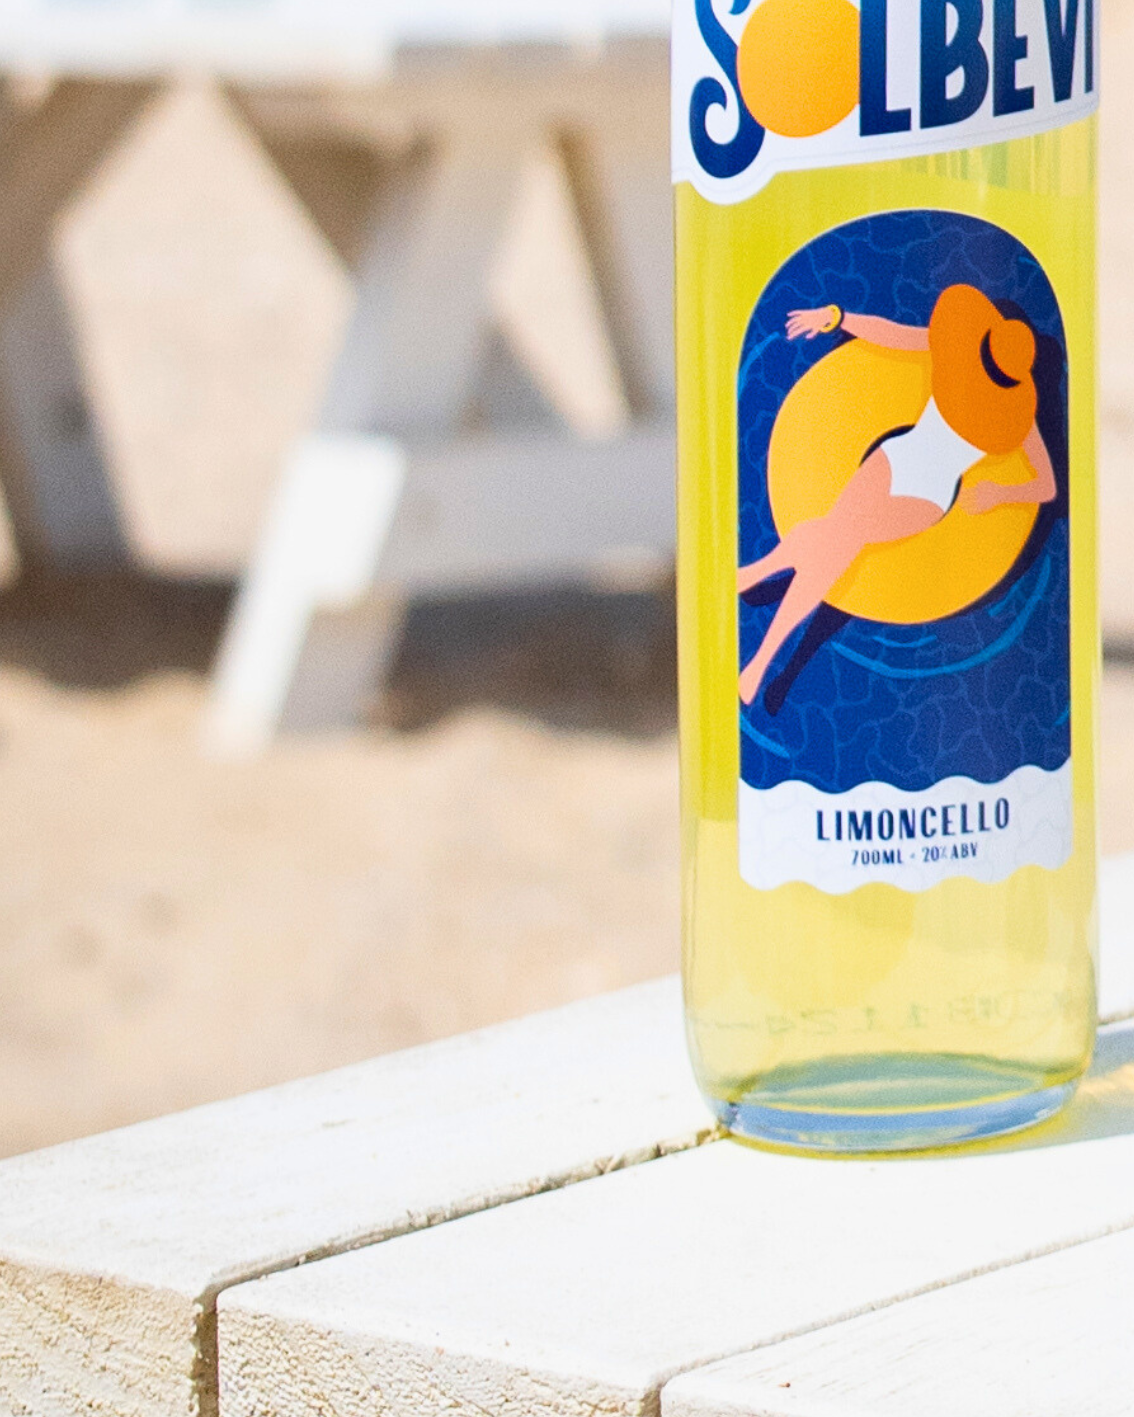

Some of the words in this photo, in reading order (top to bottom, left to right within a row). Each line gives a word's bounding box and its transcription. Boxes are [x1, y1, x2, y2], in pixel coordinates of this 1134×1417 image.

[816, 797, 1010, 842] LIMONCELLO
[852, 847, 903, 866] 700ML
[950, 842, 979, 860] ABV
